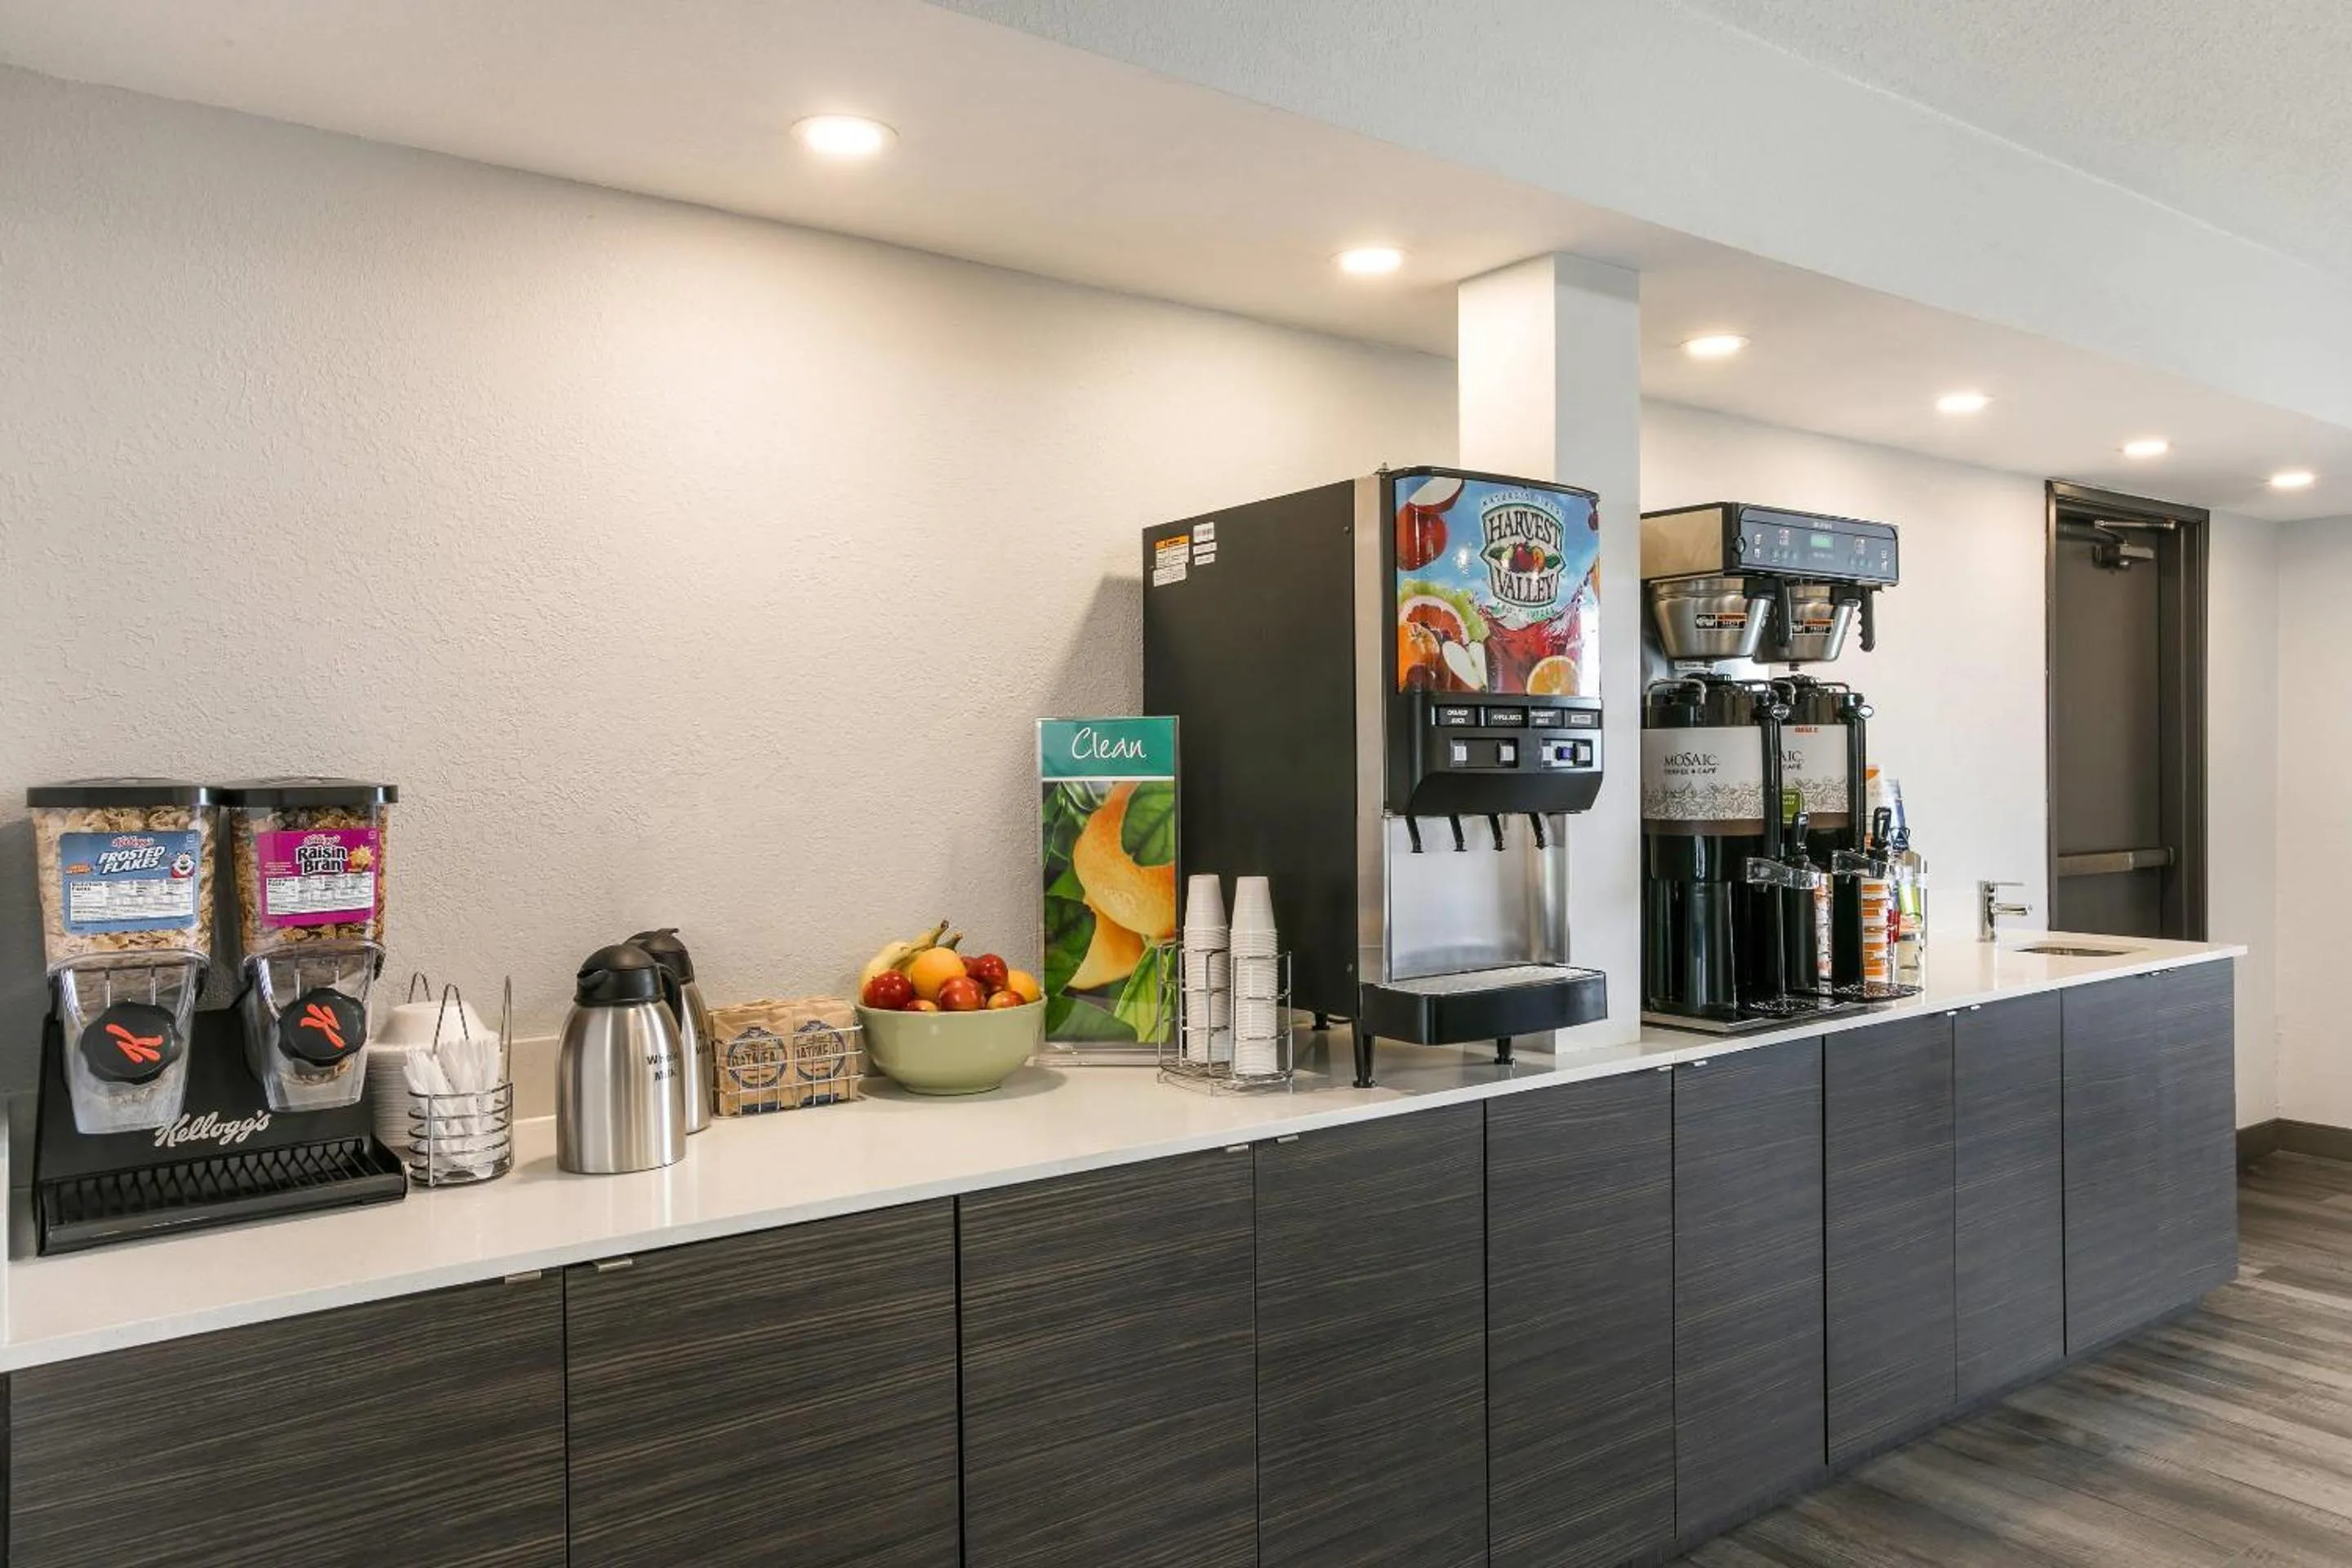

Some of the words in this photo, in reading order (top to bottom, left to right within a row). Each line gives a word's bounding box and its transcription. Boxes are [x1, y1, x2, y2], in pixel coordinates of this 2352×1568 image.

[1488, 510, 1561, 554] HARVEST
[1494, 566, 1555, 604] VALLEY
[1071, 727, 1147, 760] Clean
[1664, 752, 1716, 767] MOSAIC
[98, 846, 166, 865] FROSTED
[296, 846, 347, 861] Raisin
[102, 858, 159, 874] FLAKES
[303, 858, 341, 874] Bran
[154, 1109, 272, 1147] Kellogg's
